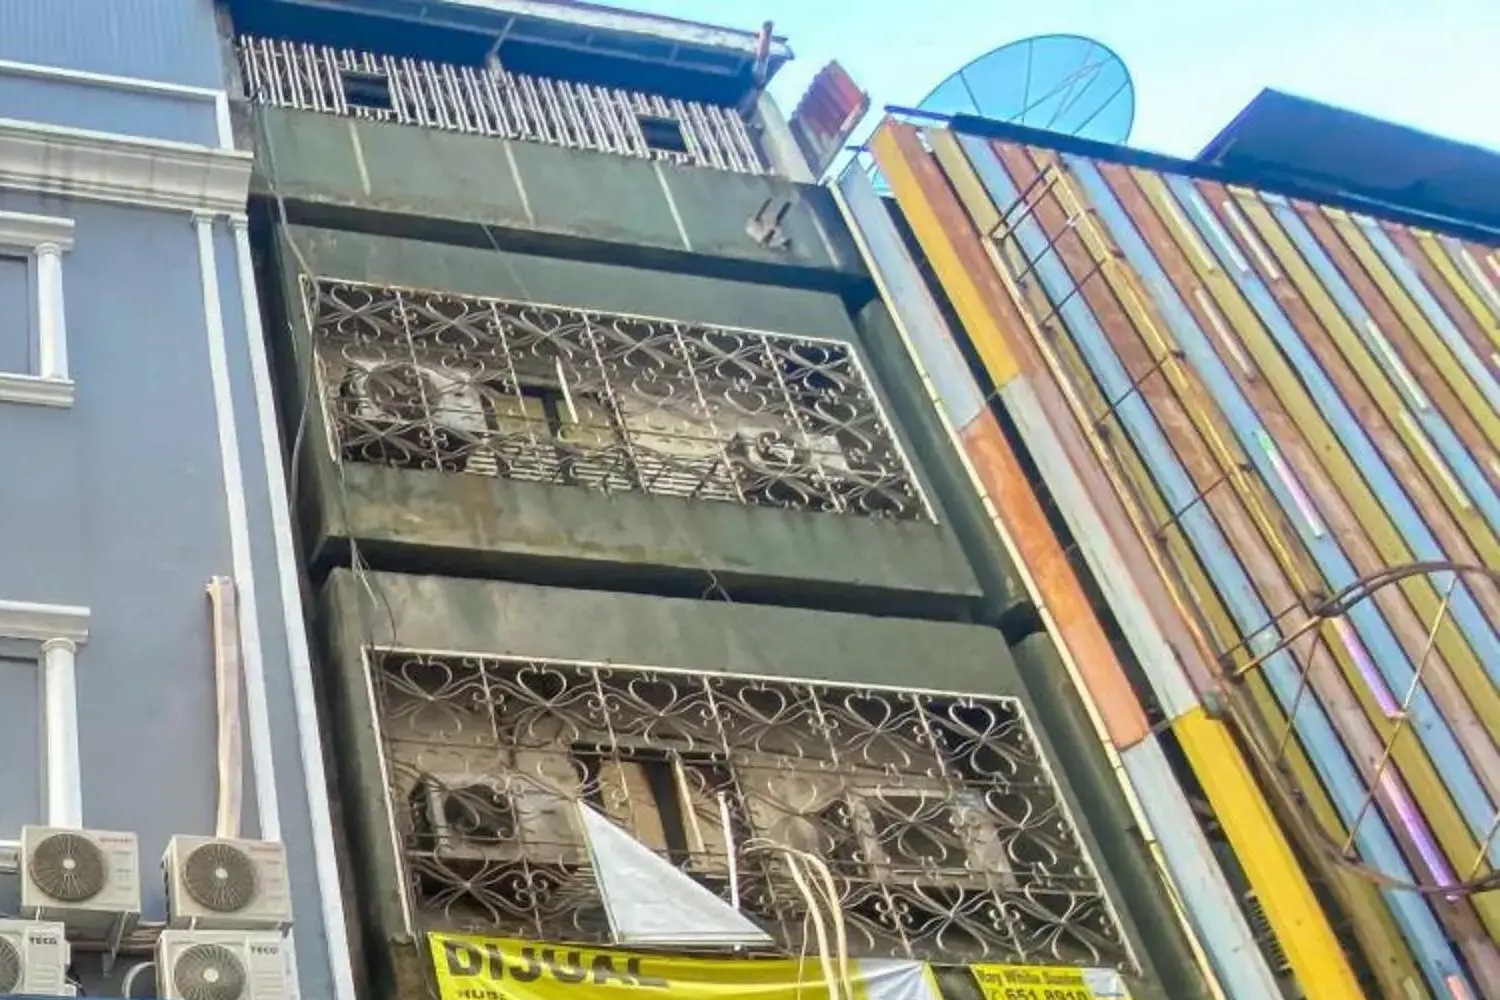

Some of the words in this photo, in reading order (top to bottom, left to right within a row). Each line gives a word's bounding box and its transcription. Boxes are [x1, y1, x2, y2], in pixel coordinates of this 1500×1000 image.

[28, 936, 58, 946] TECO
[251, 946, 279, 955] TECO
[444, 940, 669, 988] DIJUAL
